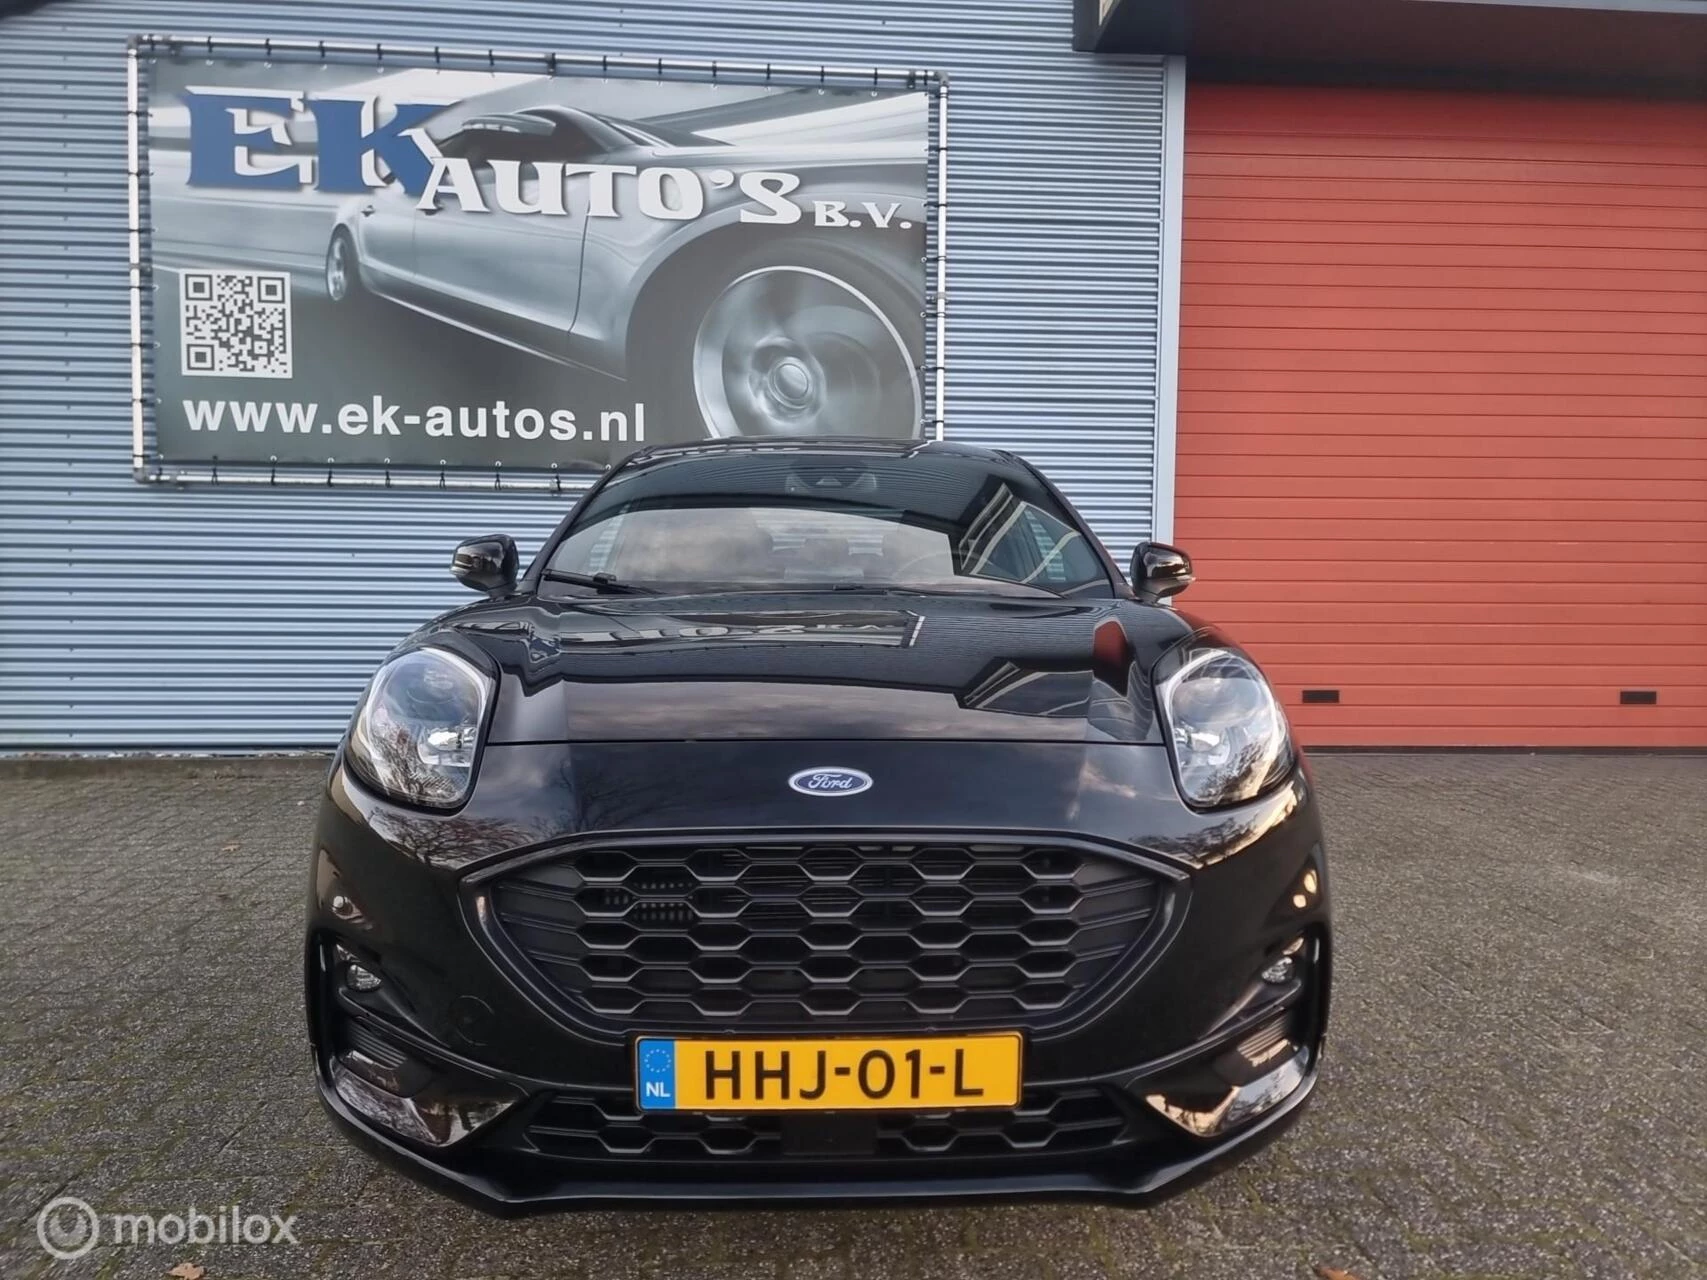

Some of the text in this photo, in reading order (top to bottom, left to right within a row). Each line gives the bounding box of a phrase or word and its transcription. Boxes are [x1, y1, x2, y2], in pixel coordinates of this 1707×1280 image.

[186, 87, 914, 228] EK AUTO'S B.V.
[182, 396, 645, 442] www.ek-autos.nl
[808, 773, 852, 789] Ford
[645, 1047, 984, 1100] NL HHJ-01-L
